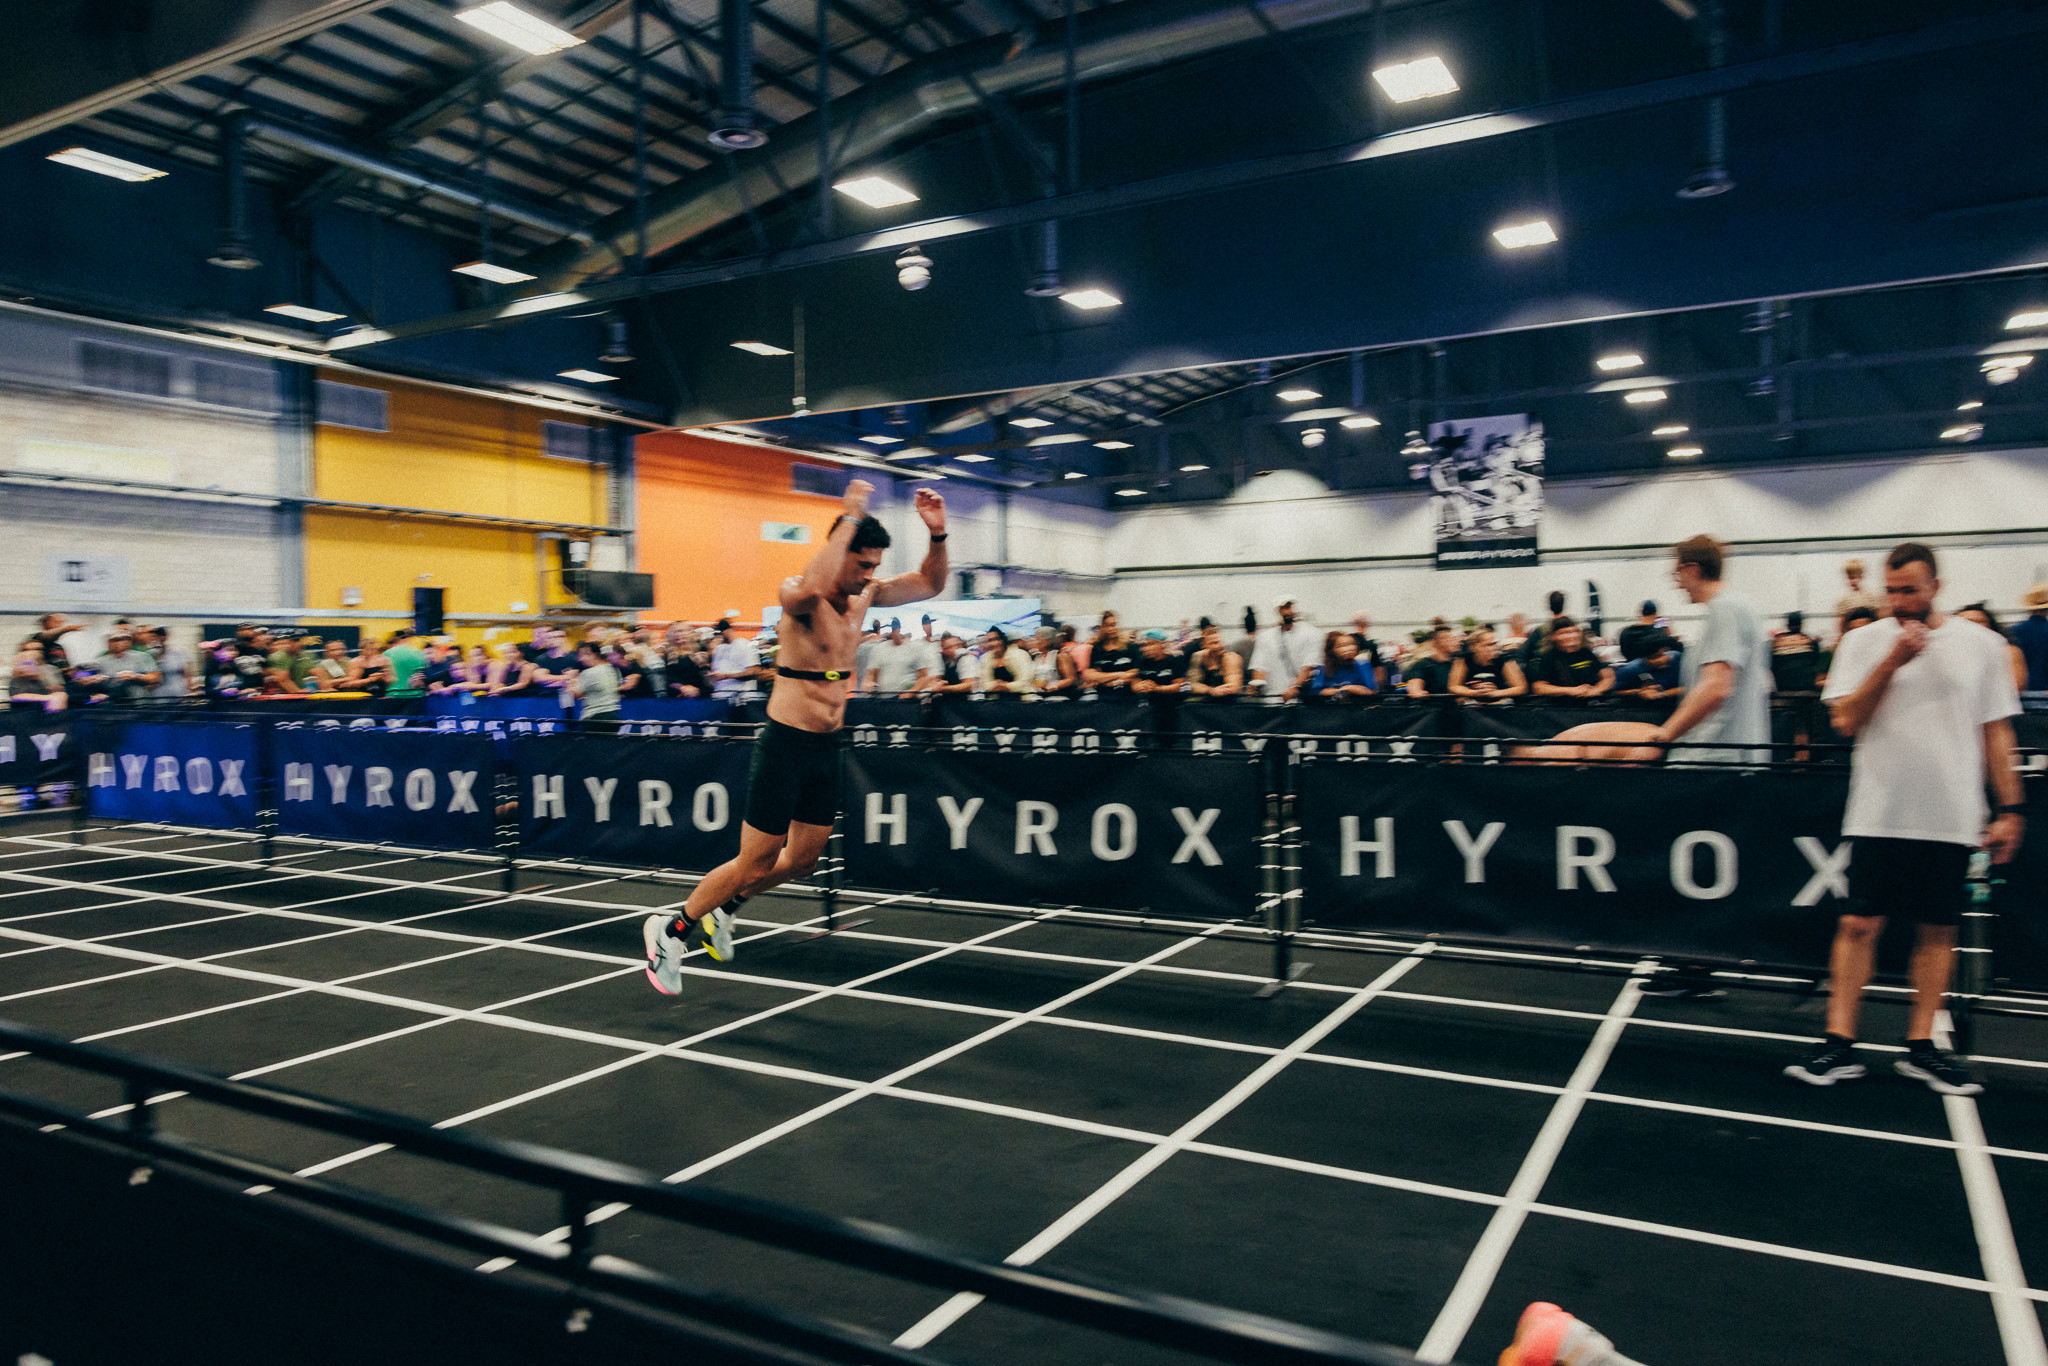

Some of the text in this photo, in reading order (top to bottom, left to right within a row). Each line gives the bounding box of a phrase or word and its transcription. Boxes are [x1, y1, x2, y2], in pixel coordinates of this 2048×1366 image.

[87, 752, 248, 797] HYROX
[284, 762, 480, 814] HYROX
[532, 774, 730, 832] HYRO
[864, 792, 1224, 867] HYROX
[1339, 815, 1853, 906] HYROX
